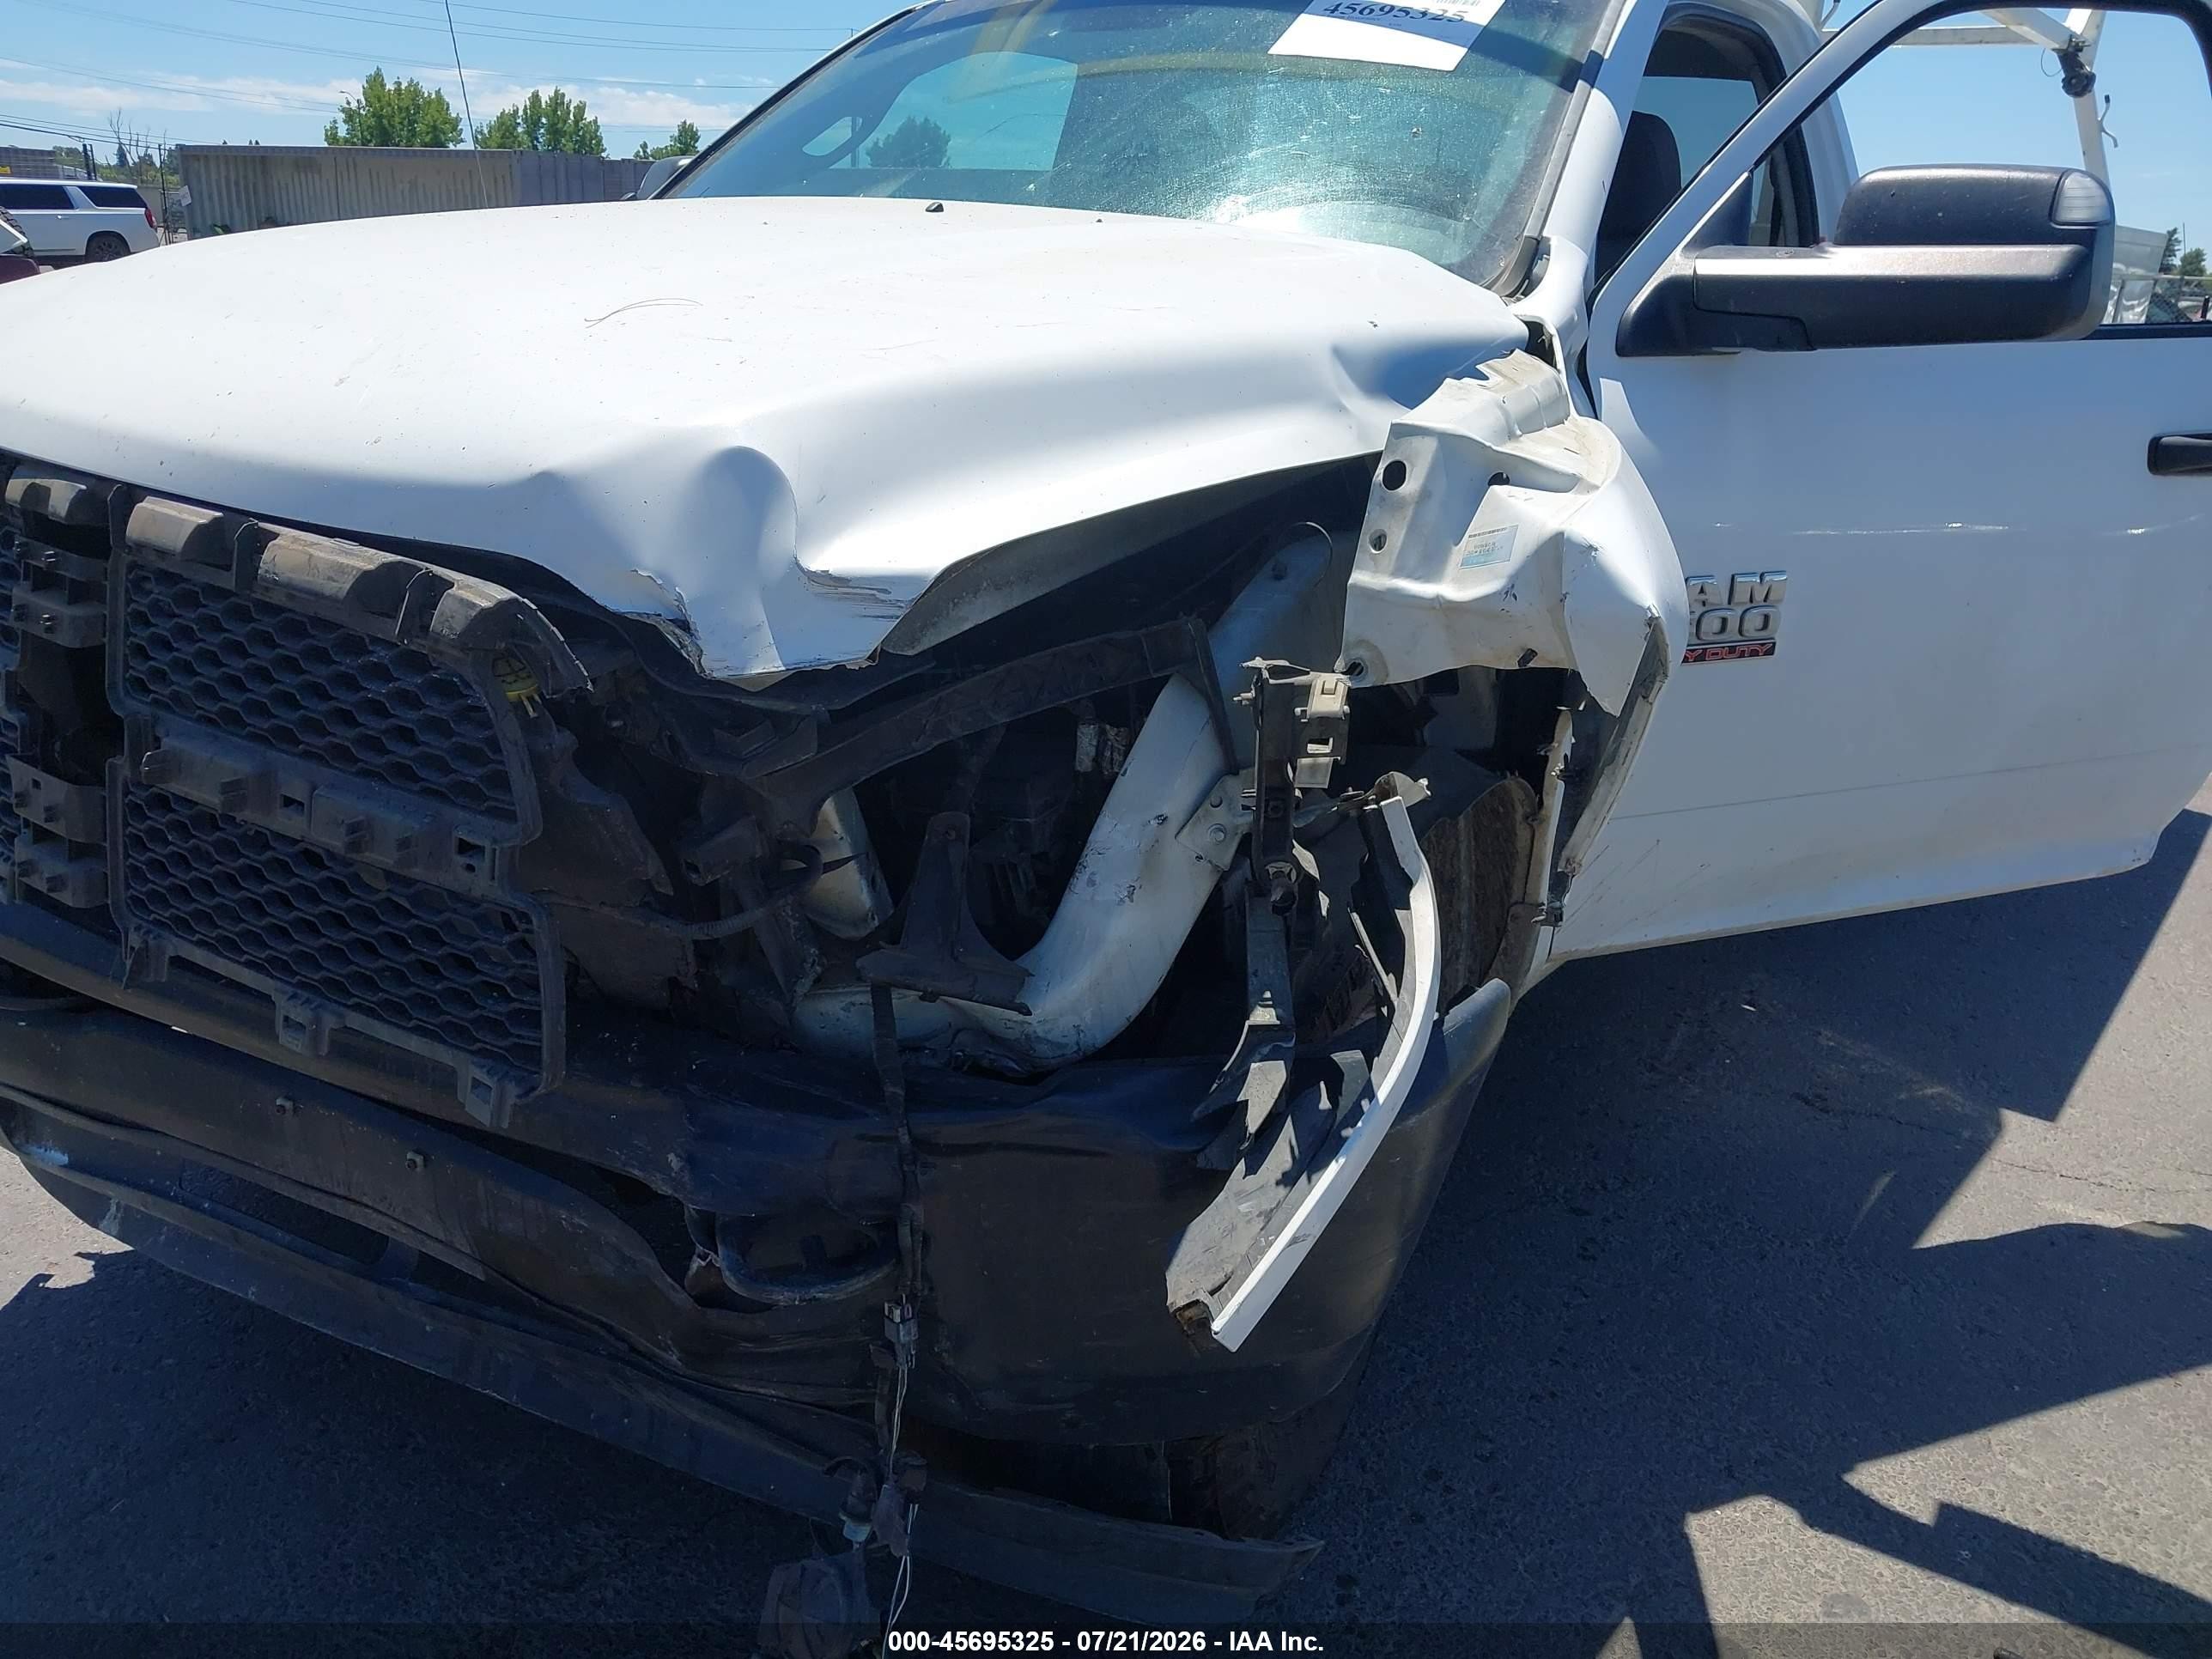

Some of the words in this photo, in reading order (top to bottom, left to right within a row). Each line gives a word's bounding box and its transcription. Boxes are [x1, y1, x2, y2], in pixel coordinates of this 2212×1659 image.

[1323, 2, 1469, 23] 45695325
[1685, 570, 1787, 605] AM
[1705, 643, 1773, 661] DUTY
